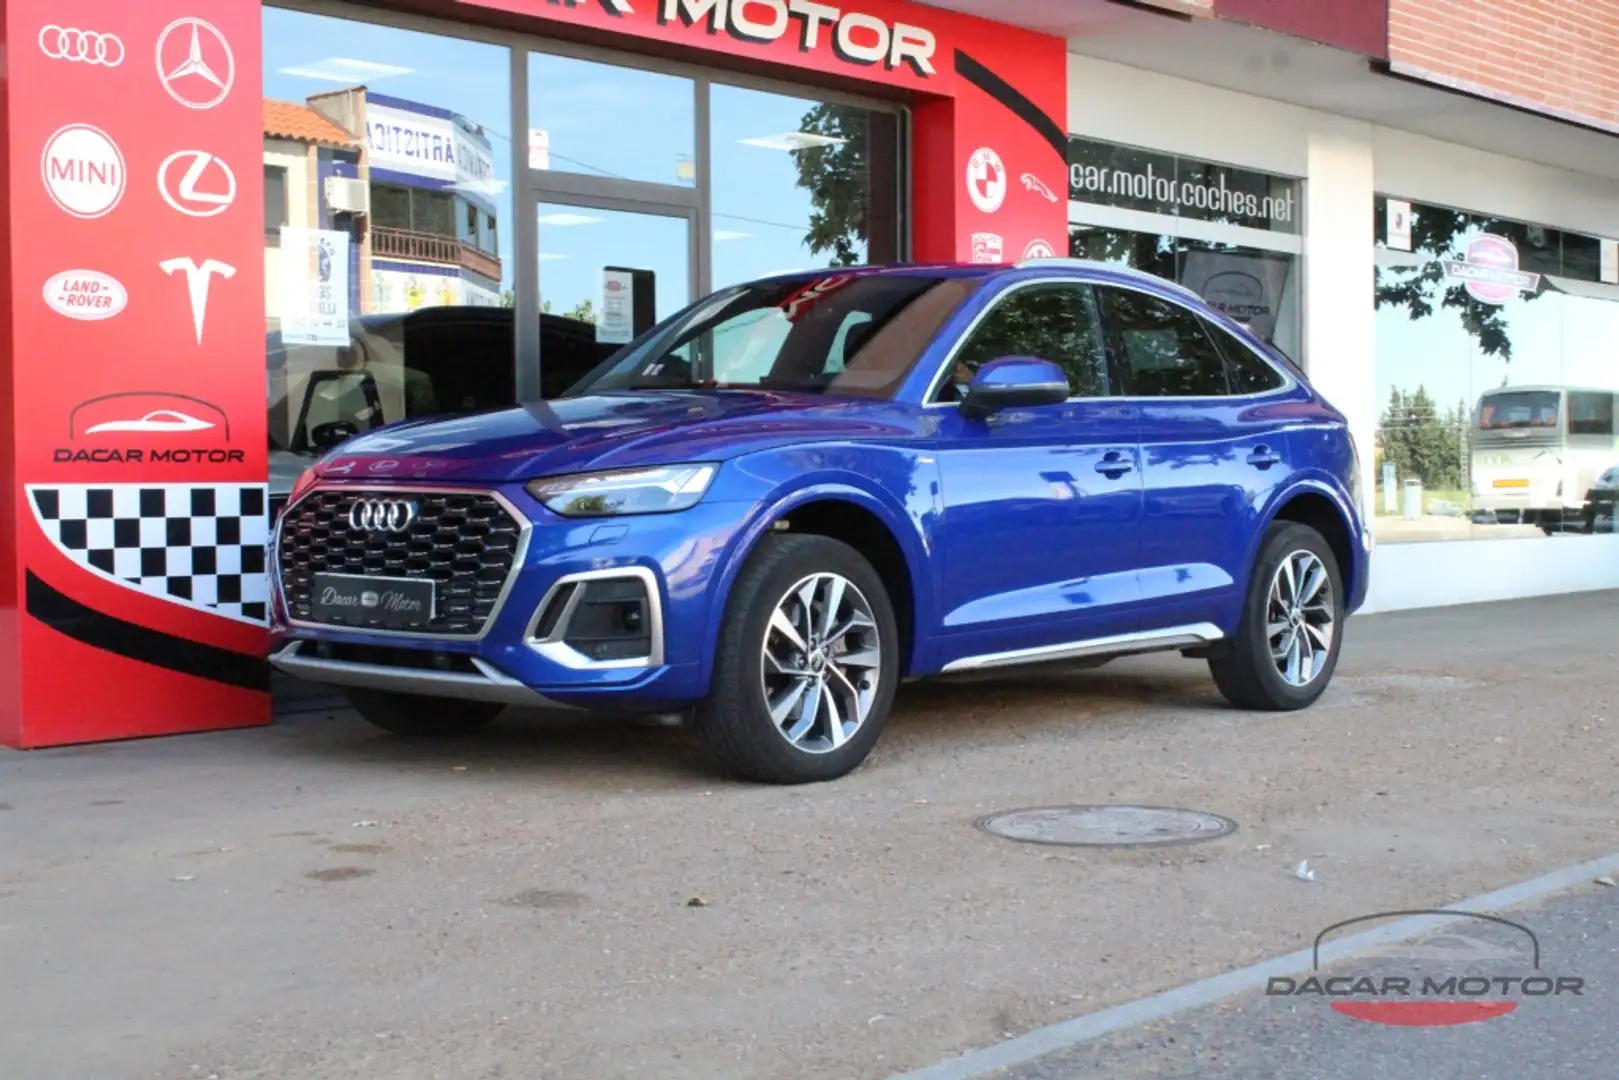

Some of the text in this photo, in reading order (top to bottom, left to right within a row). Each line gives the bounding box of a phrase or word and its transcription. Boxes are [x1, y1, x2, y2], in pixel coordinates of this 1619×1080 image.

[663, 0, 937, 75] MOTOR
[51, 155, 116, 187] MINI
[53, 448, 245, 463] DACAR MOTOR
